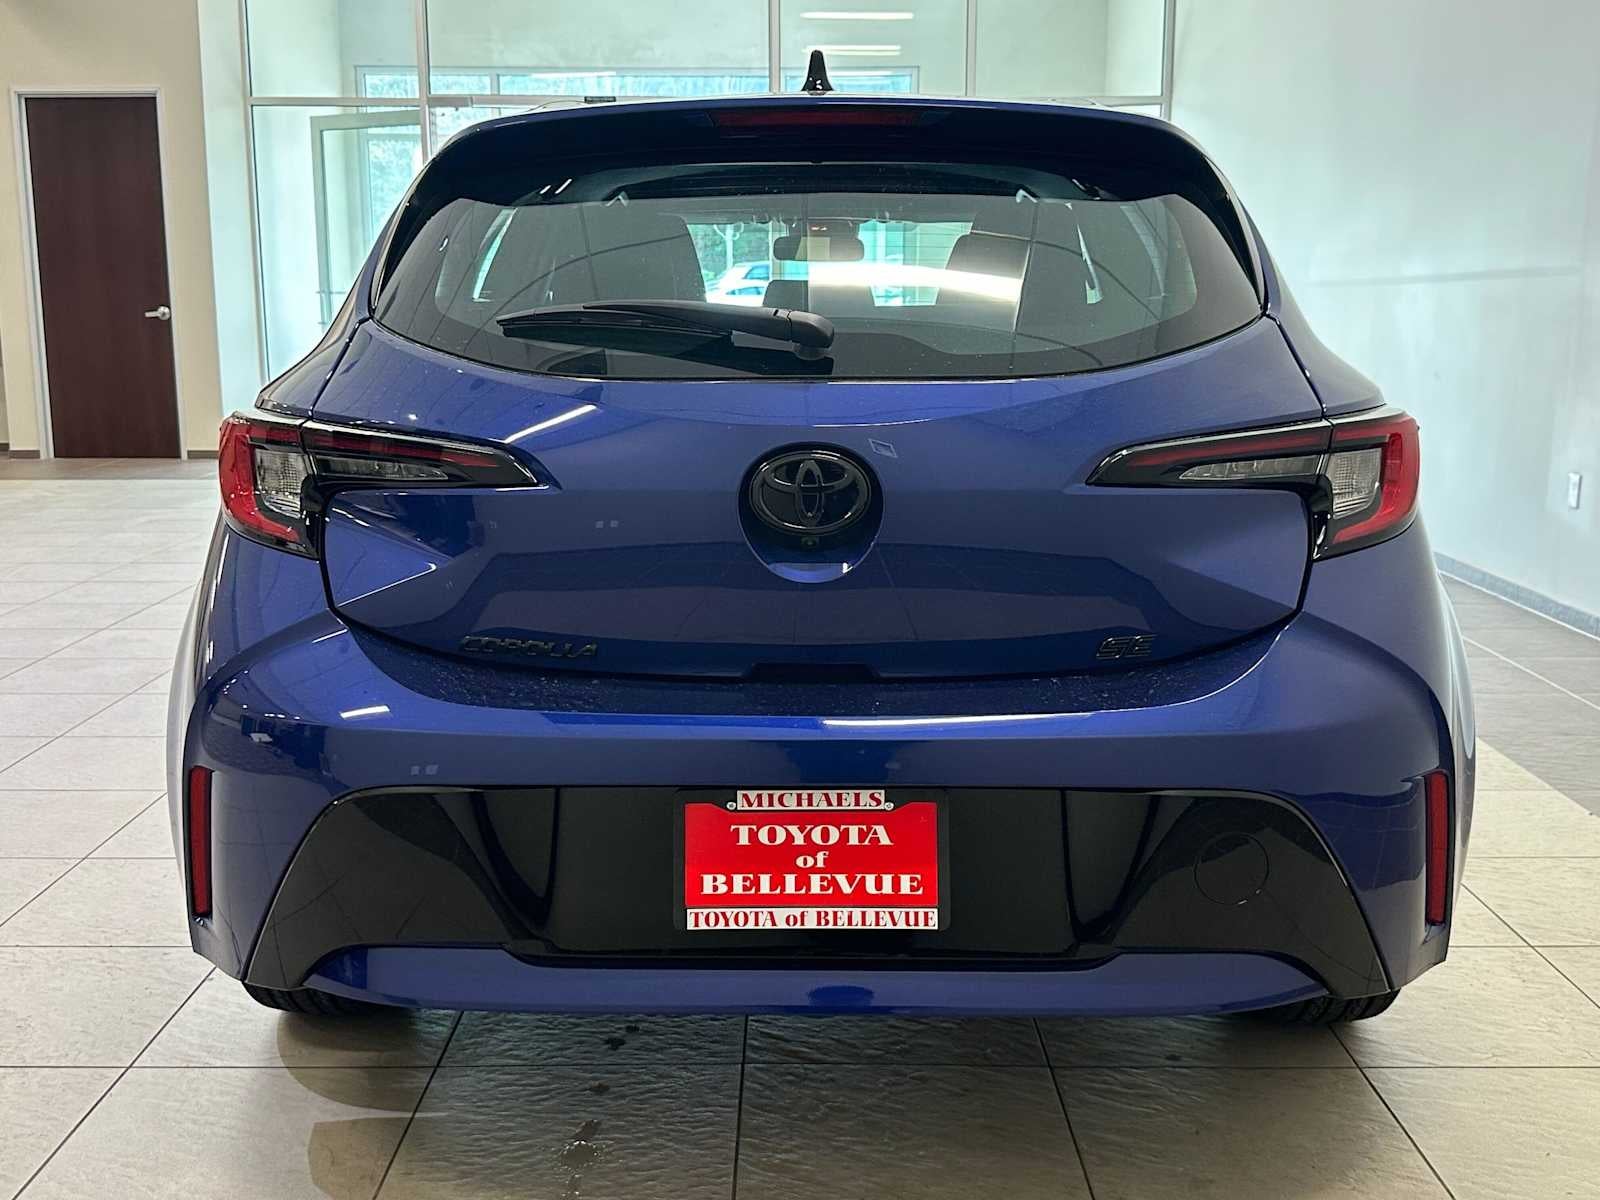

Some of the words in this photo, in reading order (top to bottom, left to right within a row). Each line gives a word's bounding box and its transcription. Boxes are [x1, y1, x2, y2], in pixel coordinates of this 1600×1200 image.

[461, 635, 597, 658] COROLLA
[1096, 634, 1154, 659] SE
[740, 791, 883, 808] MICHAELS
[730, 824, 894, 846] TOYOTA
[795, 851, 829, 868] of
[700, 873, 924, 896] BELLEVUE
[689, 910, 778, 928] TOYOTA
[785, 910, 809, 927] of
[815, 910, 937, 928] BELLEVUE
